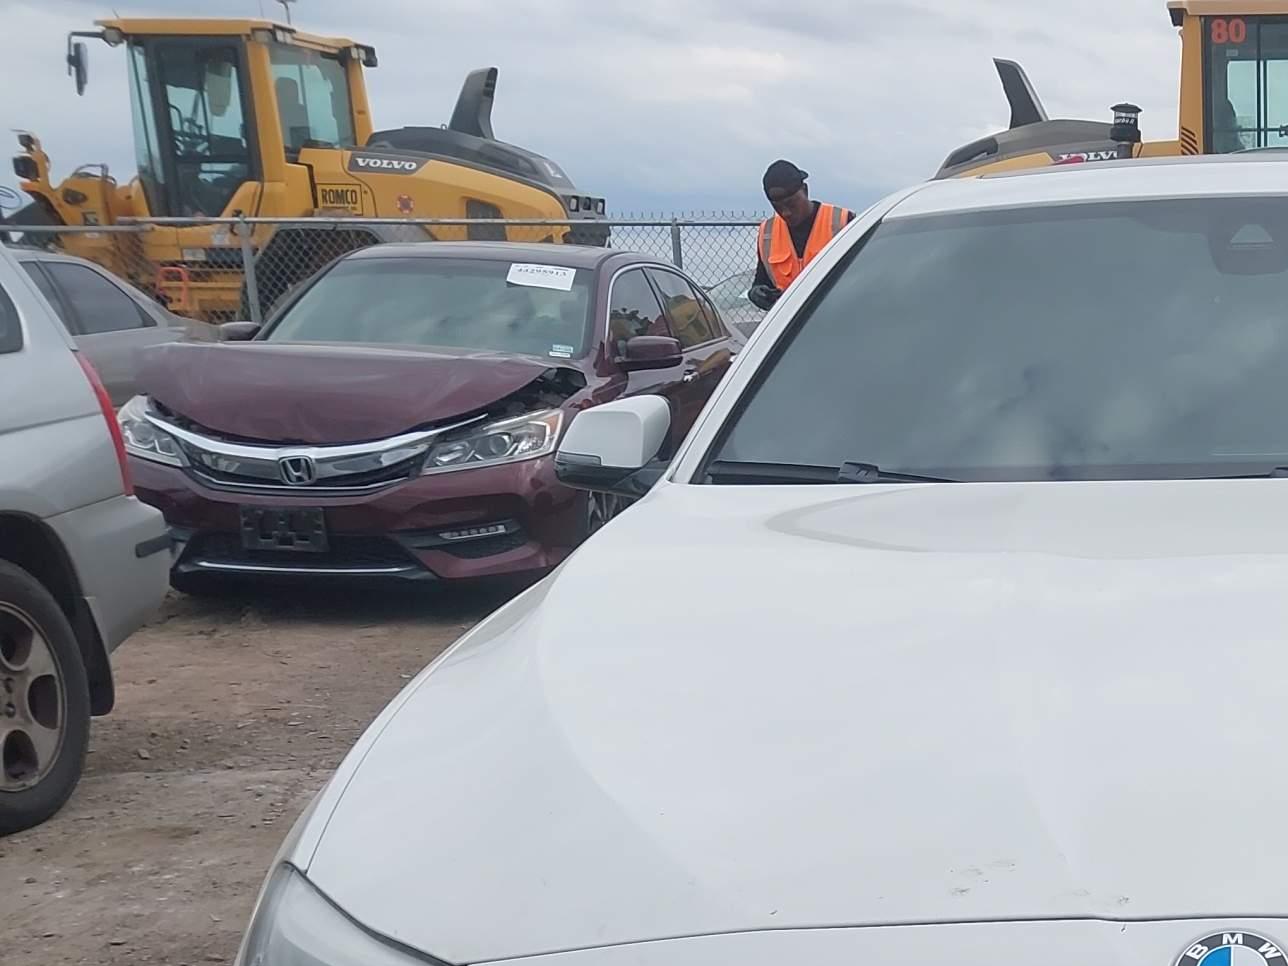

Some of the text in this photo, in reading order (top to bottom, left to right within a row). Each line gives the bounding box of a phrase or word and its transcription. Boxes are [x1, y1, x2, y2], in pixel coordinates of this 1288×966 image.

[1210, 18, 1246, 44] 80
[355, 157, 417, 170] VOLVO
[1059, 150, 1118, 162] VOLV
[321, 188, 358, 205] ROMCO
[1185, 933, 1282, 960] BMW
